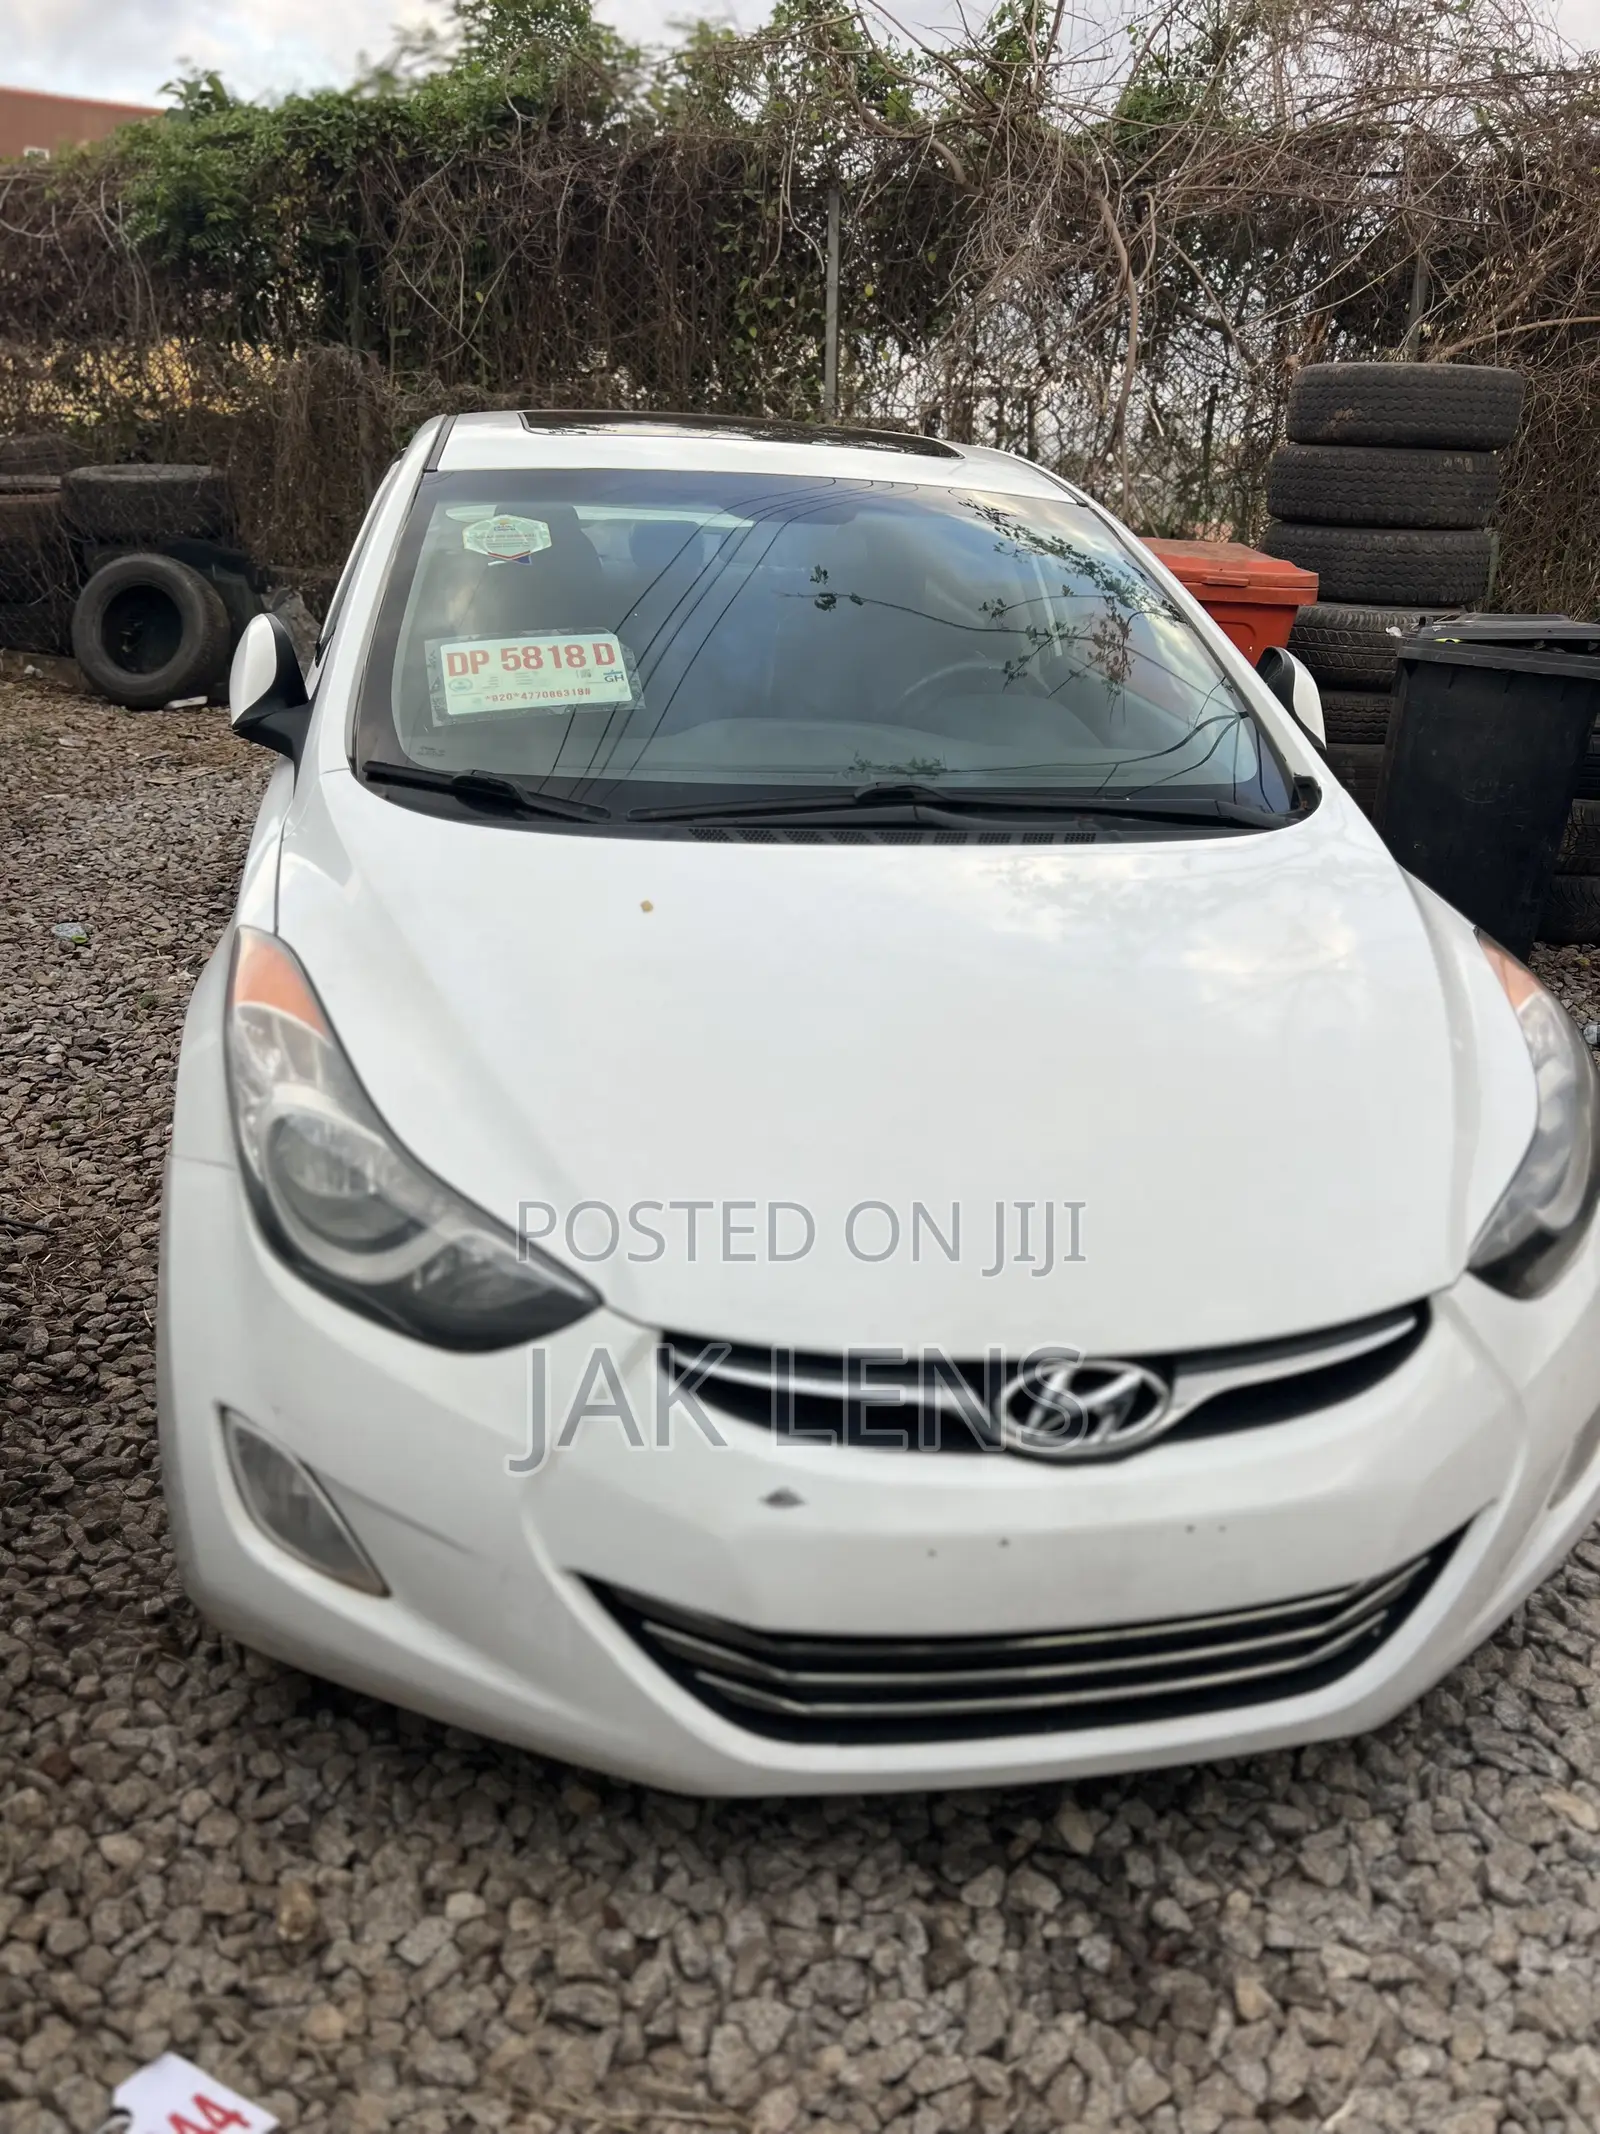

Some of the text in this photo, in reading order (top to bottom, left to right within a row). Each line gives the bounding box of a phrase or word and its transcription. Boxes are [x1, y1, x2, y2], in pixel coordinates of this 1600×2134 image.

[446, 642, 616, 677] DP 5818 D
[604, 674, 625, 683] GH
